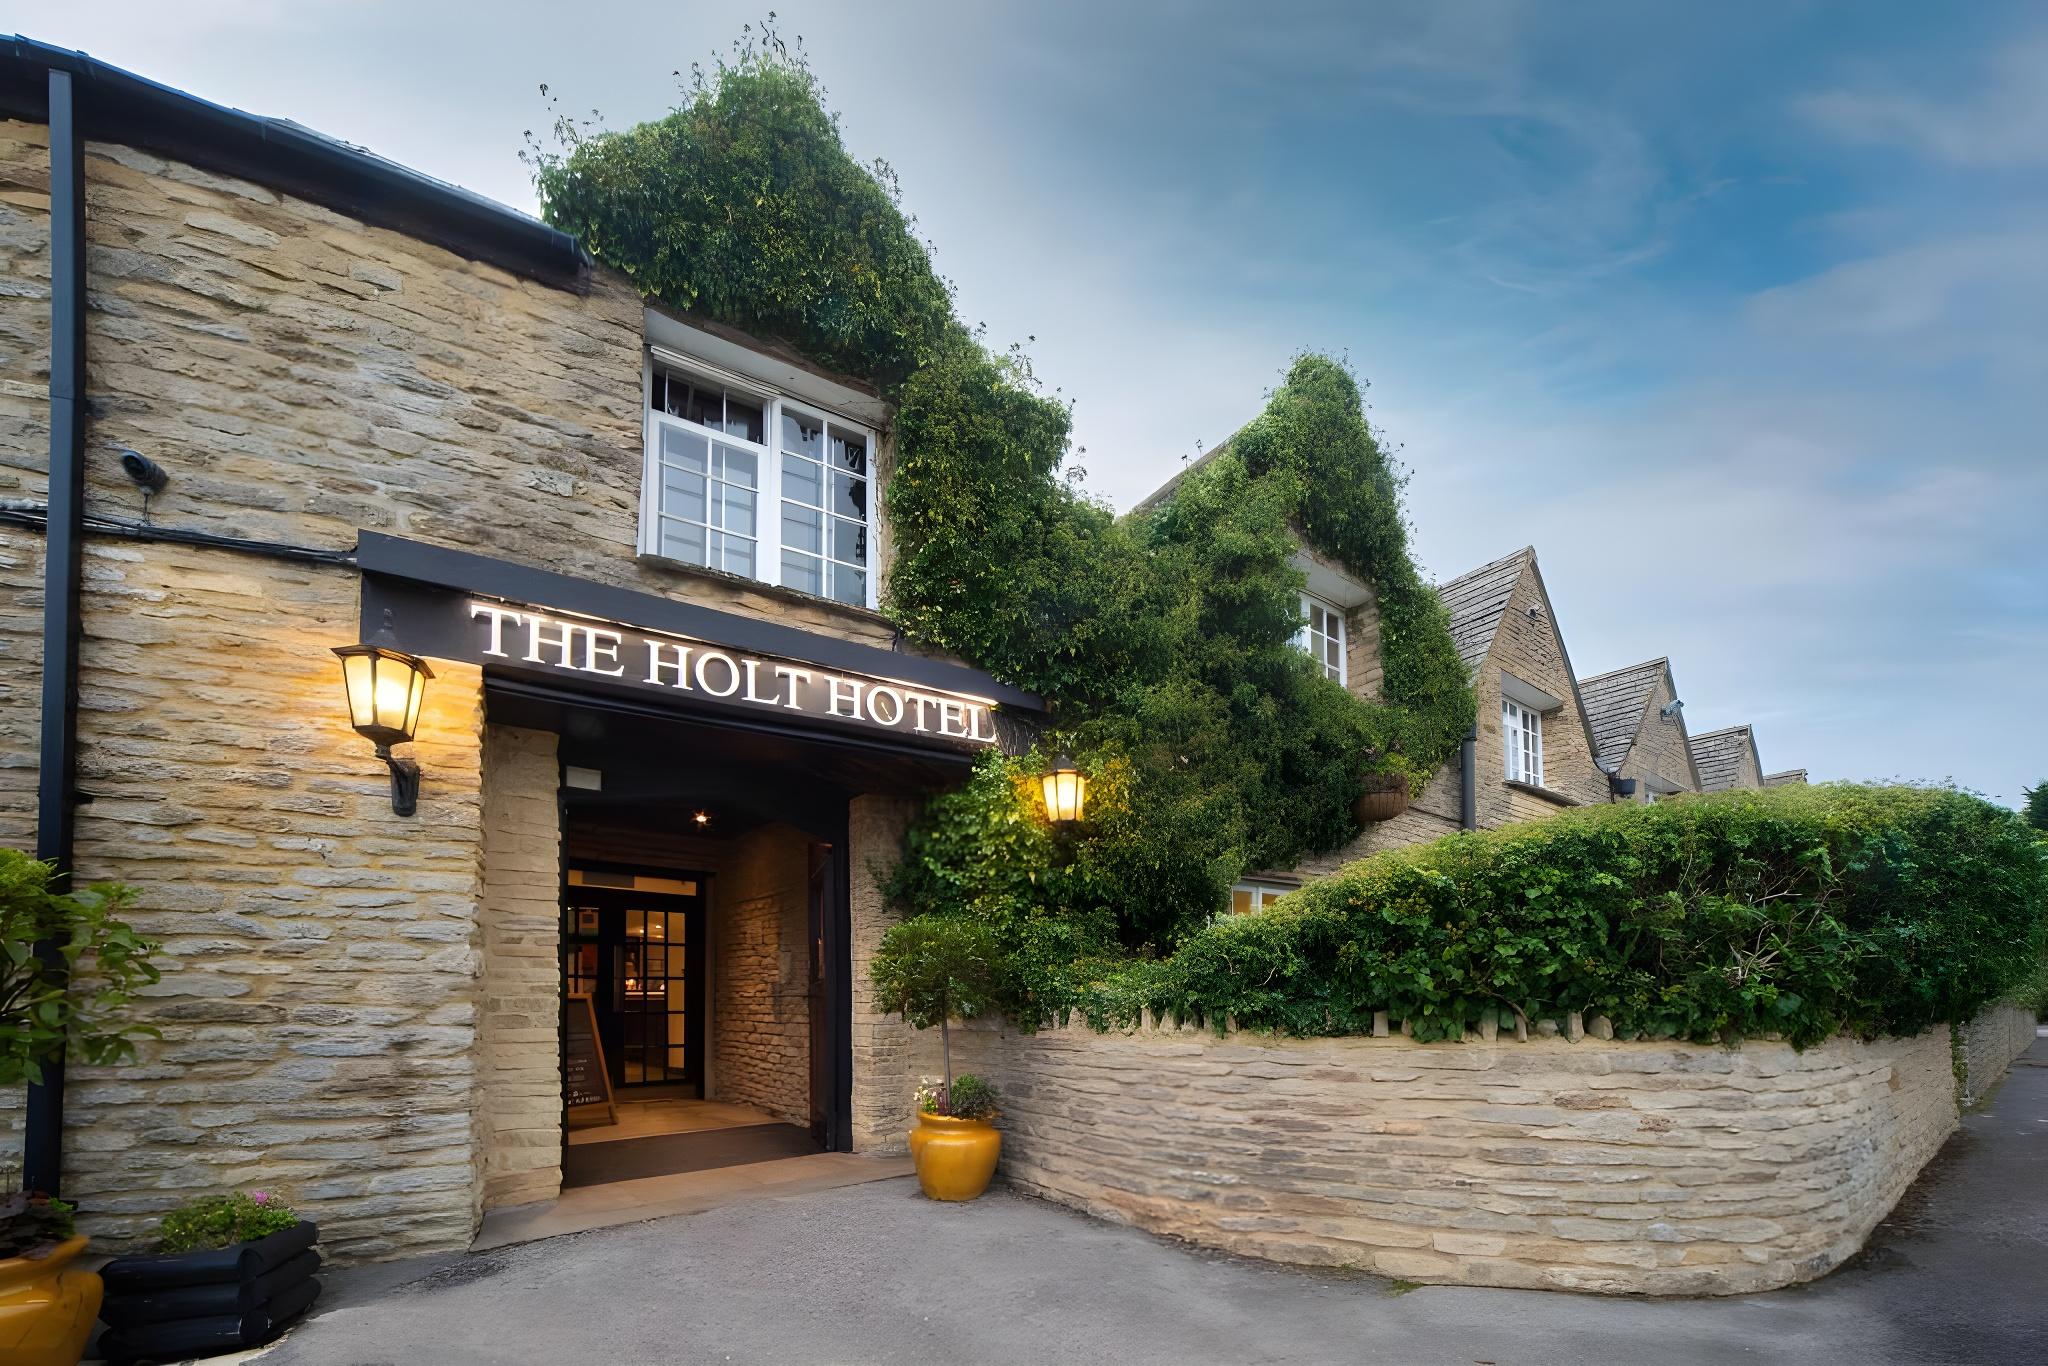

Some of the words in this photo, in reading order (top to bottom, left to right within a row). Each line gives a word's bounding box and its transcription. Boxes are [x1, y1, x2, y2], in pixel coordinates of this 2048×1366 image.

[471, 604, 625, 677] THE
[642, 639, 811, 710] HOLT
[824, 675, 997, 742] HOTEL
